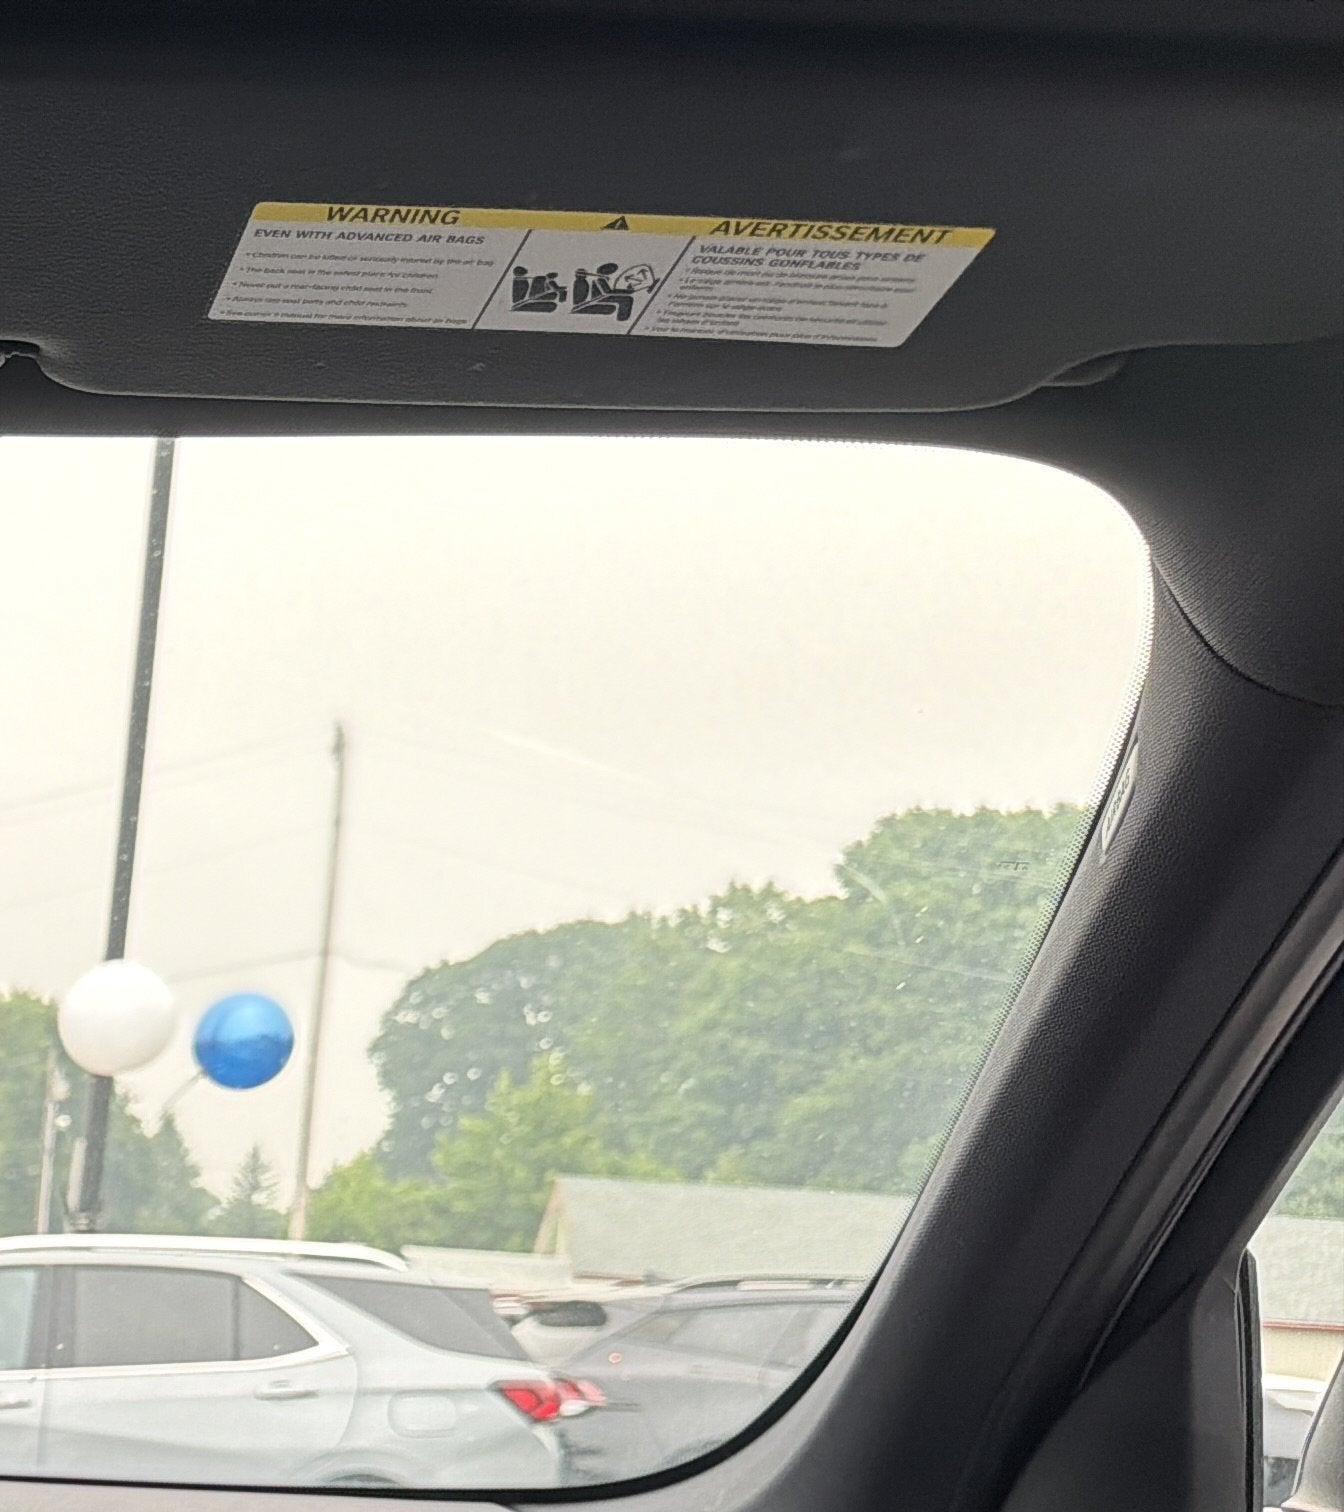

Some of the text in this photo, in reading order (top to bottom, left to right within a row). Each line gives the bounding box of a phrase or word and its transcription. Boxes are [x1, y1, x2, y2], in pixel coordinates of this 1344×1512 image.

[327, 206, 461, 225] WARNING
[254, 229, 486, 245] EVEN WITH ADVANCED AIR BAGS
[710, 220, 953, 244] AVERTISSEMENT
[692, 255, 861, 271] COUSSINS GONFLABLES
[699, 244, 927, 263] VALABLE POUR TOUS TYPES DE
